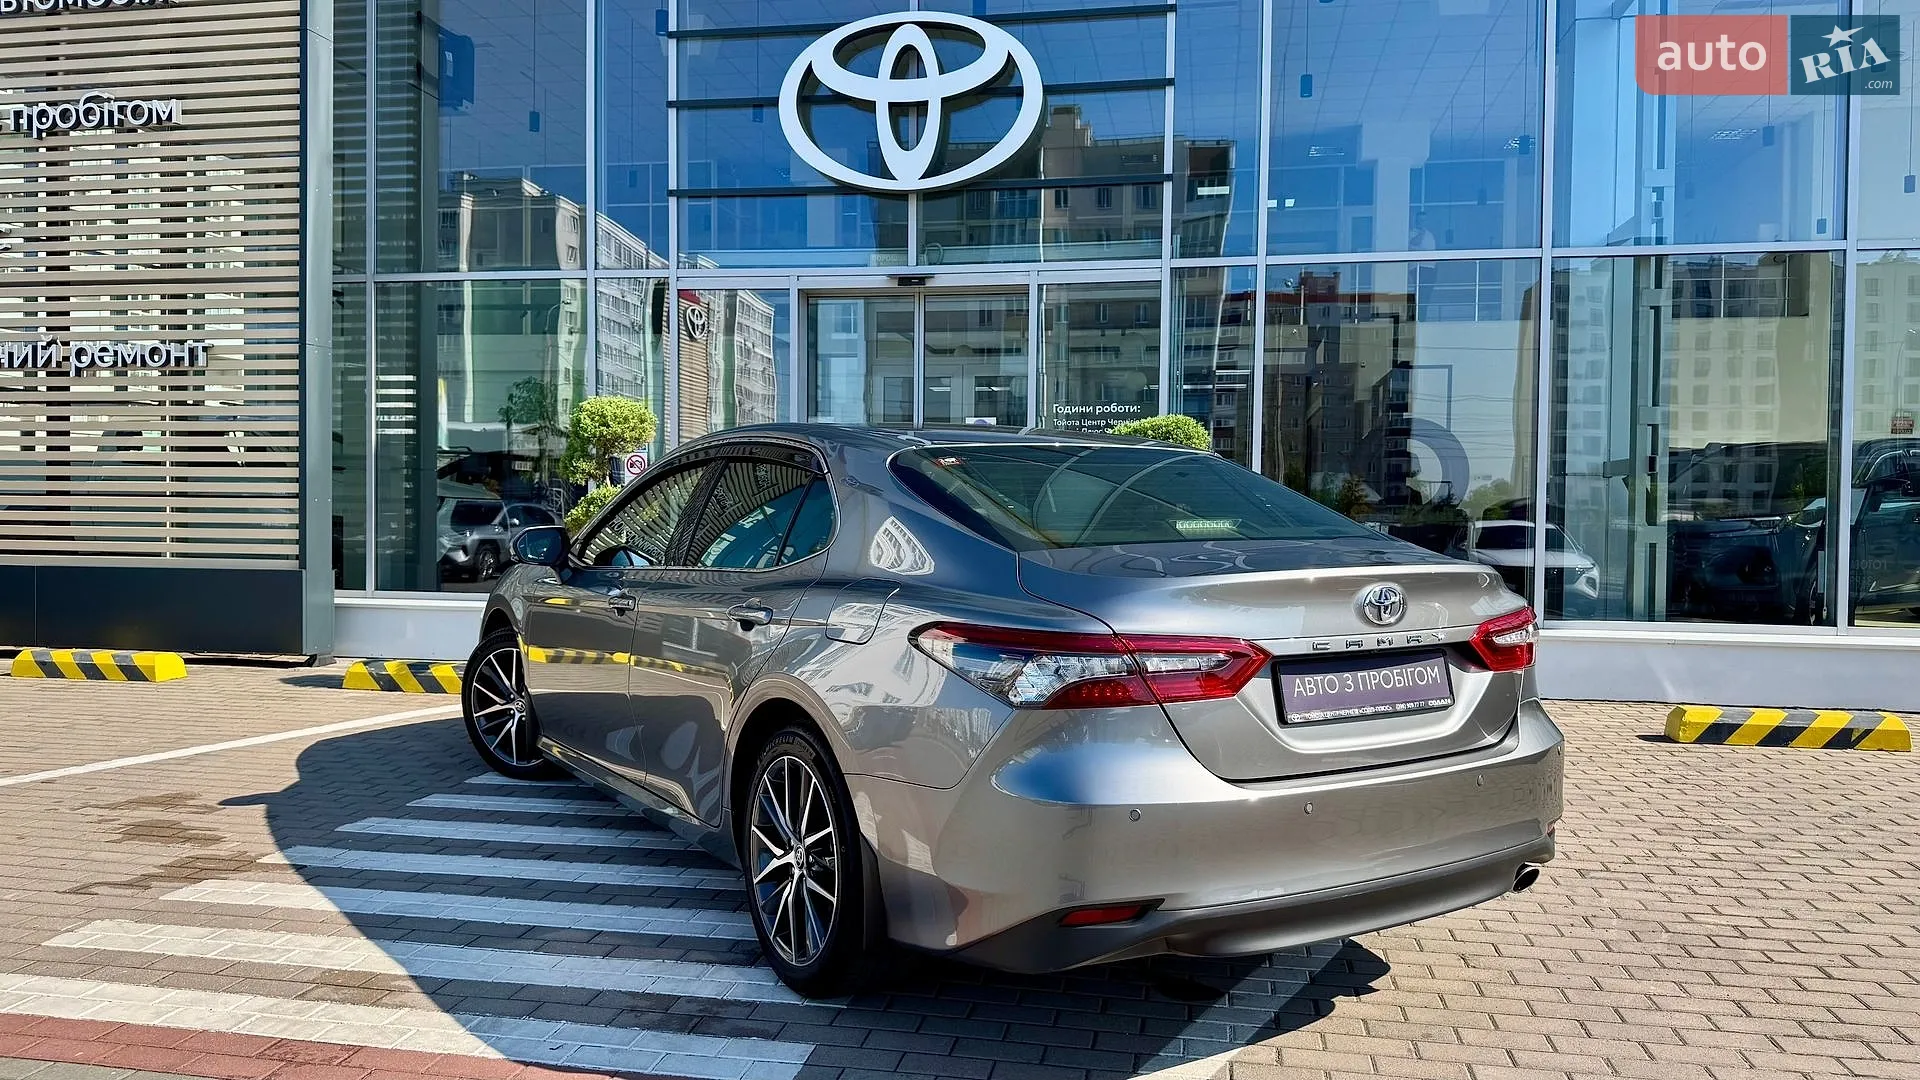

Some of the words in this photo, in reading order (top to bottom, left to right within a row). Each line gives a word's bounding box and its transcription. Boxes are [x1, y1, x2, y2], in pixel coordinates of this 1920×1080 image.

[9, 91, 178, 139] пробігом
[71, 342, 210, 377] ремонт
[1052, 403, 1093, 415] Години
[1095, 402, 1141, 416] роботи:
[1053, 418, 1080, 426] Тойота
[1081, 418, 1106, 428] Центр
[1293, 674, 1339, 698] АВТО
[1344, 673, 1354, 692] З
[1357, 665, 1441, 691] ПРОБІГОМ
